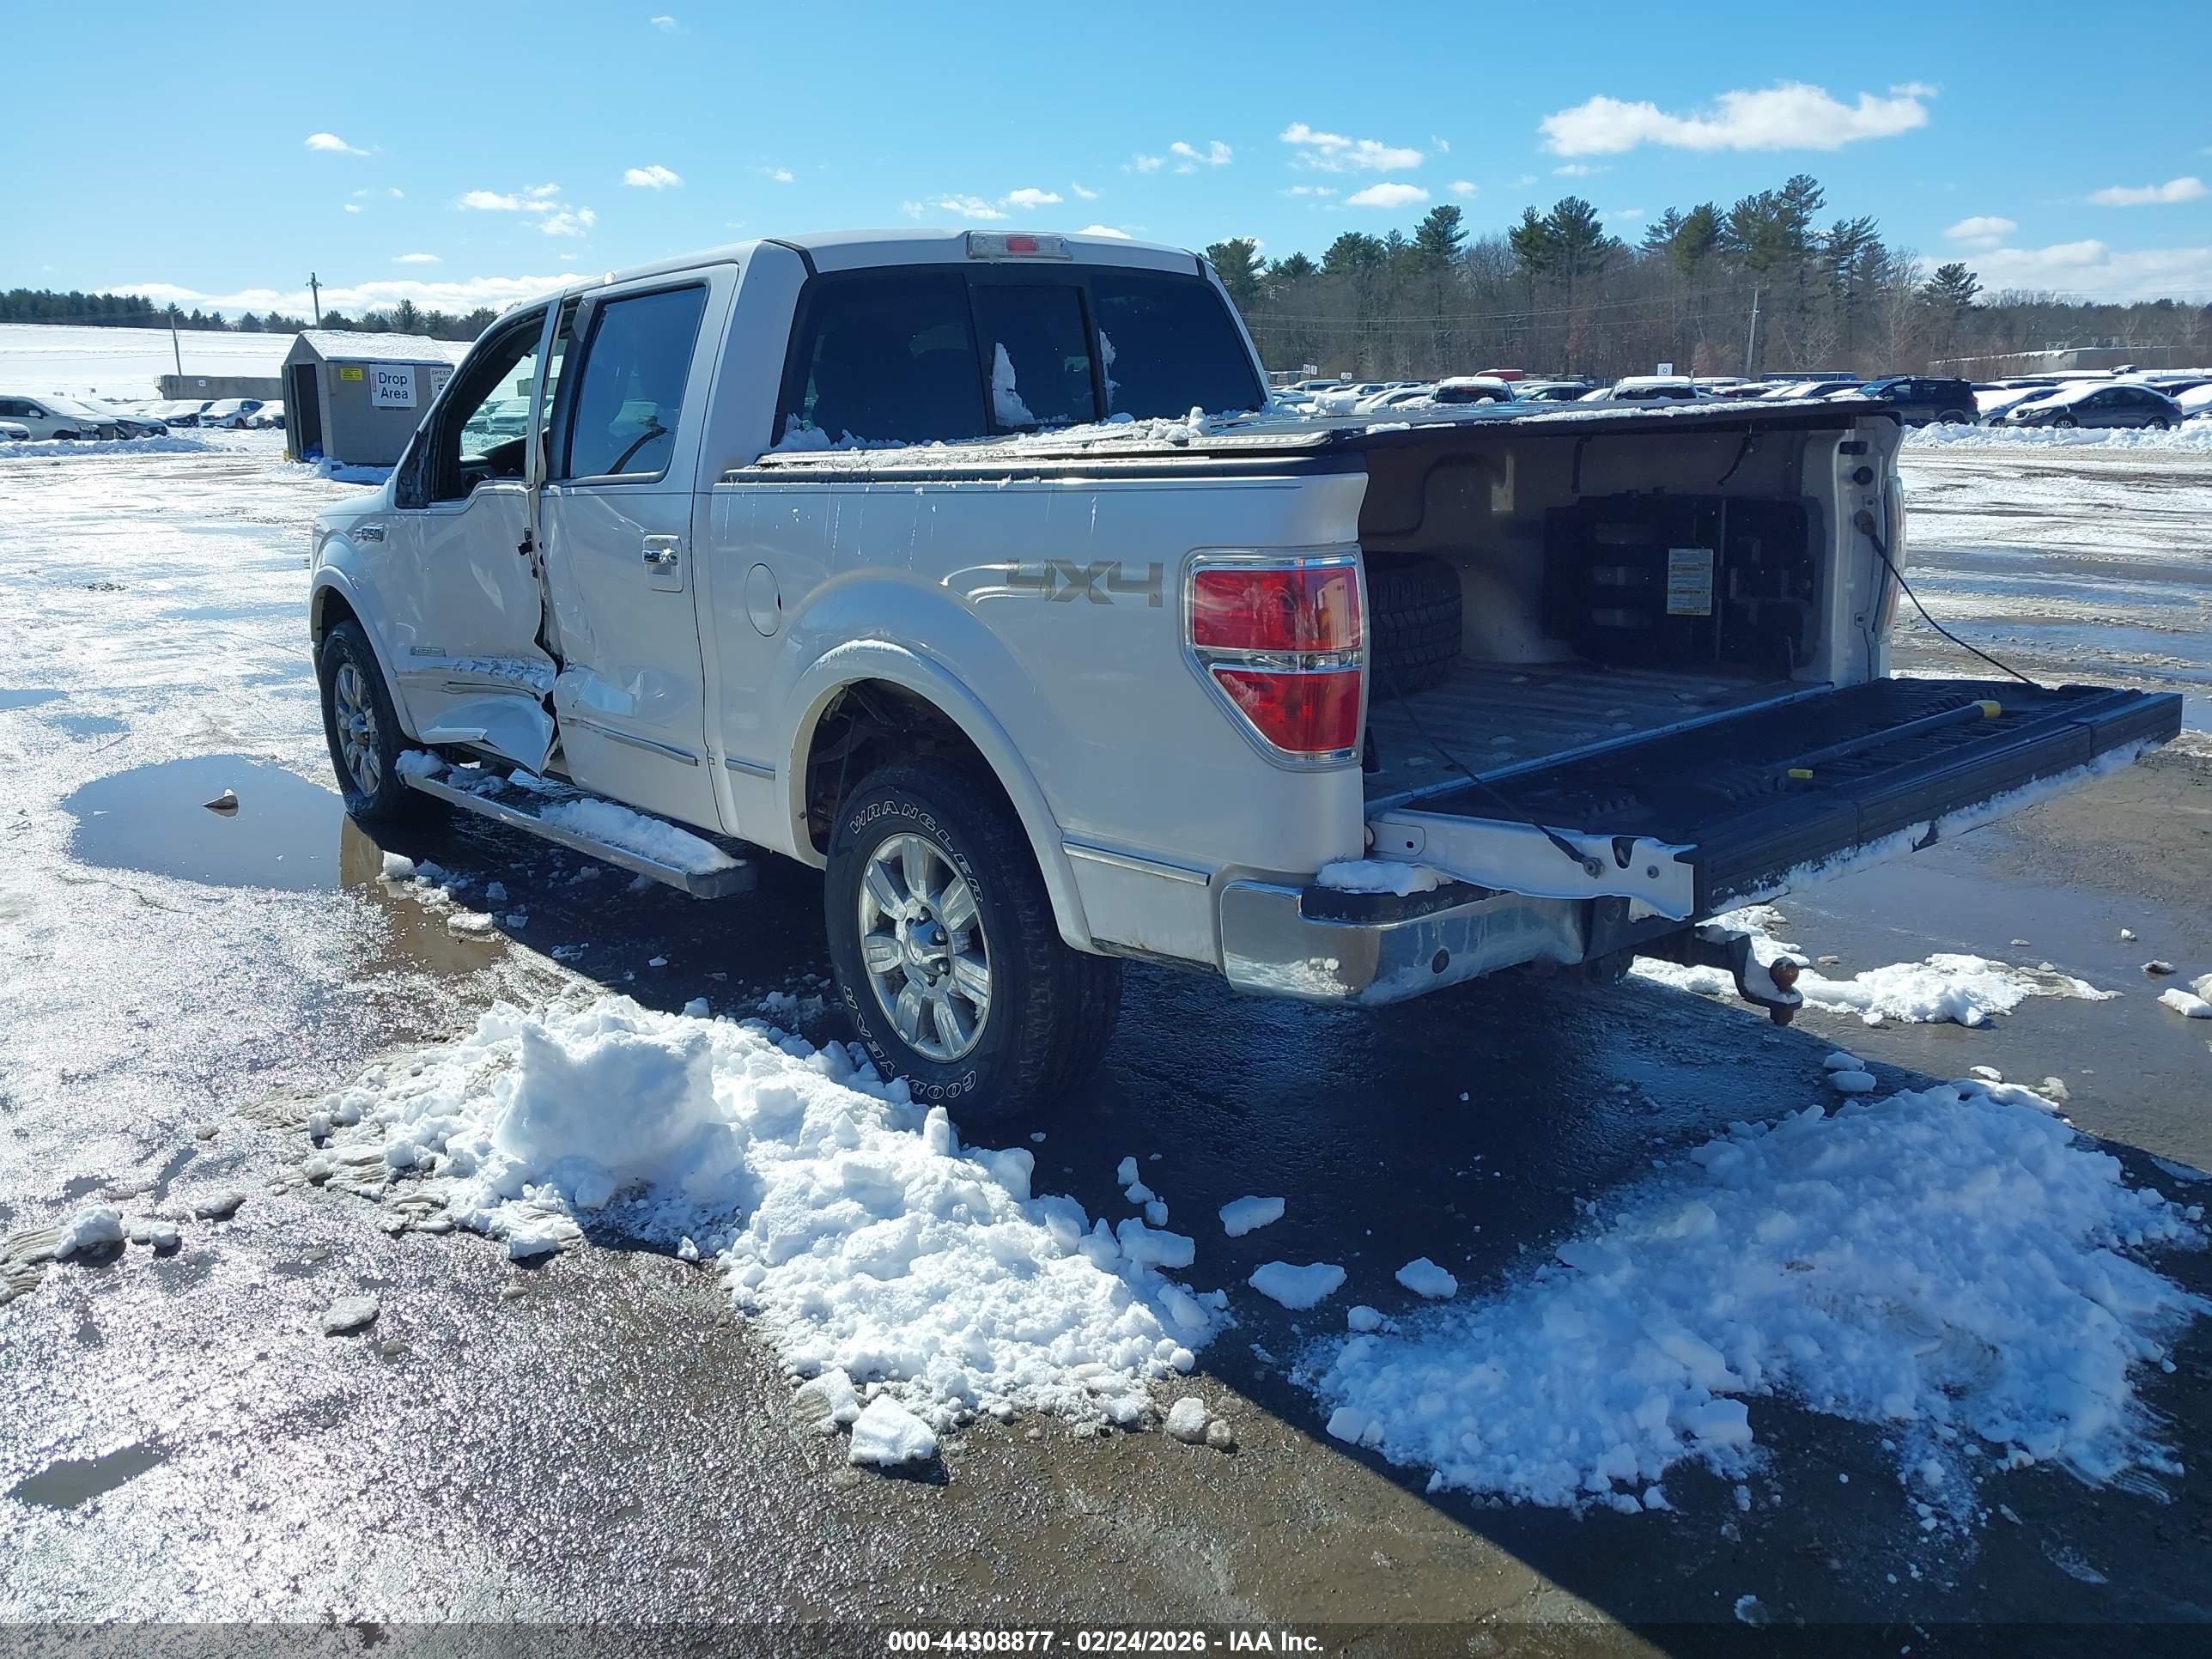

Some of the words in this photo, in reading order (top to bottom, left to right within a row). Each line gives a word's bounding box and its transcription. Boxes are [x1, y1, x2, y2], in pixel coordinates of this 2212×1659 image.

[378, 372, 408, 386] Drop
[380, 387, 409, 399] Area
[849, 800, 984, 902] WRANGLER
